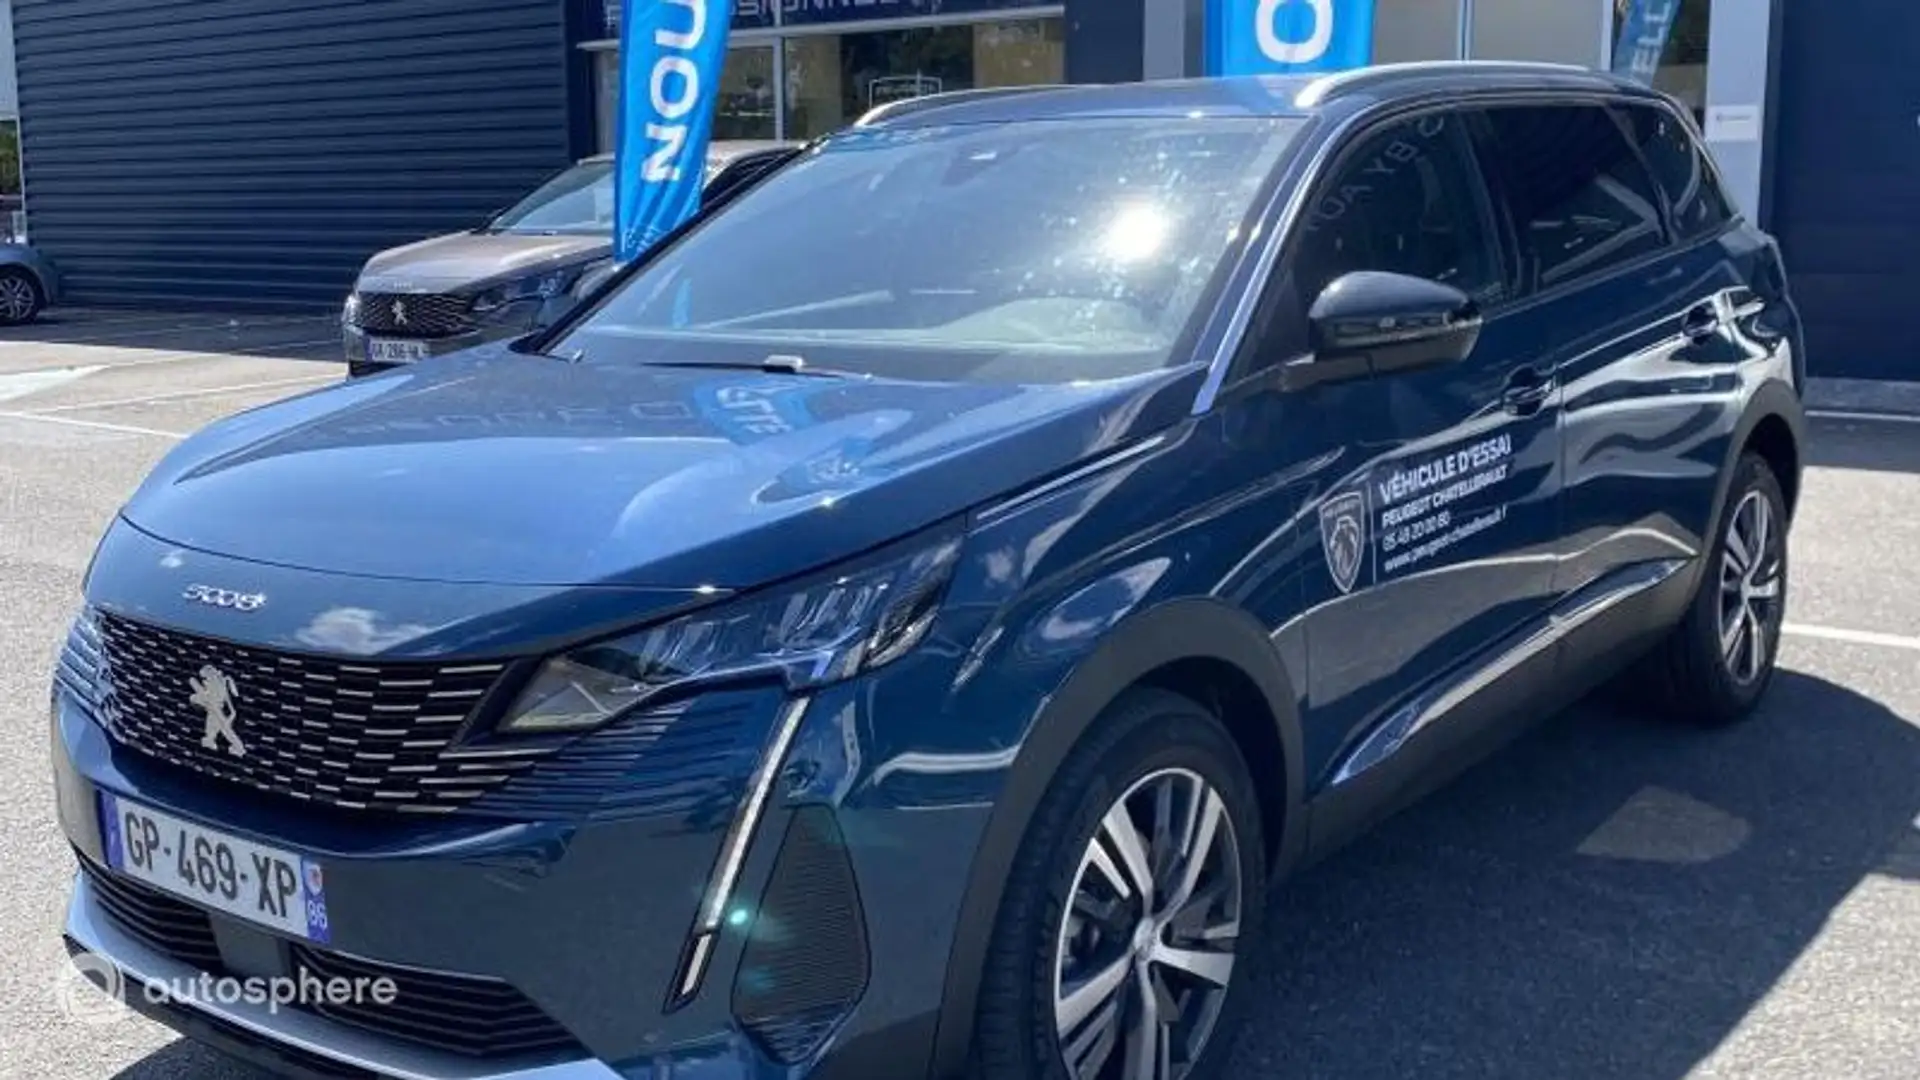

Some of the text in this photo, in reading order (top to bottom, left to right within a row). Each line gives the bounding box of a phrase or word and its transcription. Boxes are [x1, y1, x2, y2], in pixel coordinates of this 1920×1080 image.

[1380, 433, 1512, 505] VÉHICULE D'ESSAI
[1382, 494, 1431, 529] PEUGEOT
[125, 811, 297, 918] GP-469-XP
